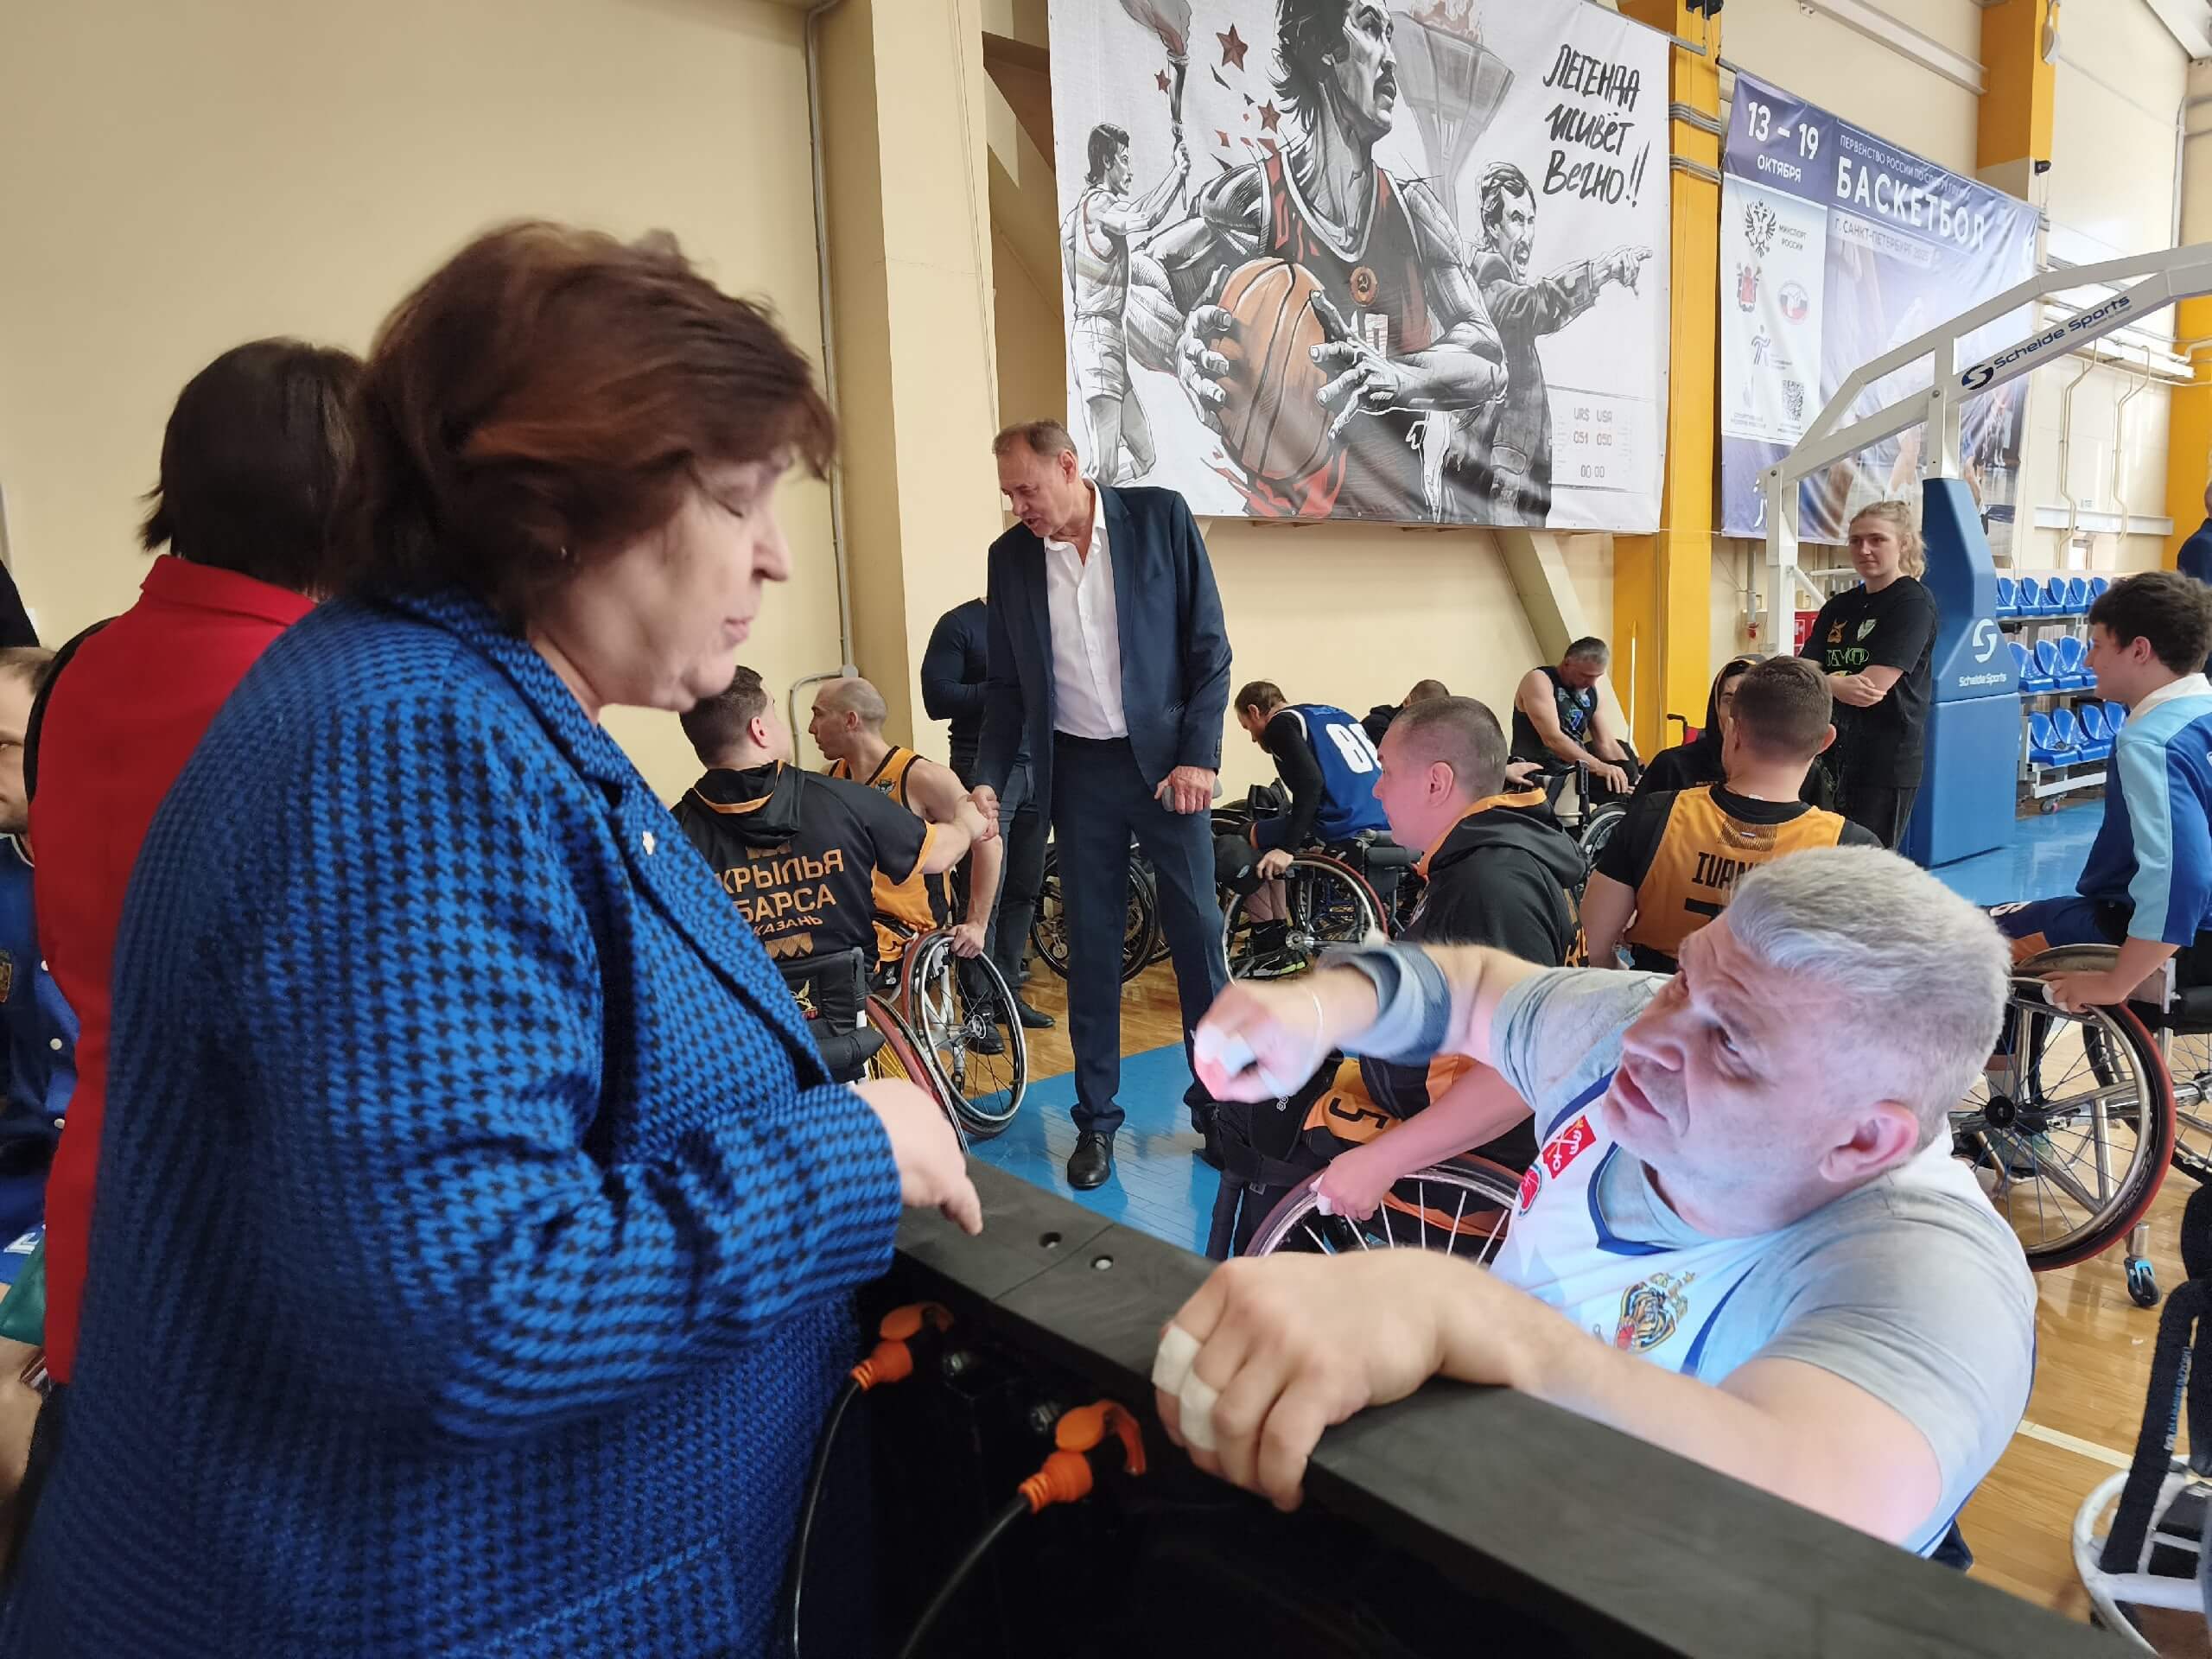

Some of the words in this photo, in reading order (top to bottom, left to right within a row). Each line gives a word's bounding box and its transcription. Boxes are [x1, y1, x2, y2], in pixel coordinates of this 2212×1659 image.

[1747, 101, 1771, 142] 13
[1798, 123, 1820, 160] 19
[1757, 154, 1802, 183] ОКТЯБРЯ
[1840, 134, 1885, 164] ПЕРВЕНСТВО
[1886, 155, 1915, 177] РОССИИ
[1835, 156, 1985, 251] БАСКЕТБОЛ
[1842, 219, 1912, 254] САНКТ-ПЕТЕРБУРГ
[1993, 329, 2066, 369] Scheide
[2069, 296, 2131, 332] Sports
[715, 849, 844, 894] КРЫЛЬЯ
[733, 883, 836, 923] БАРСА
[753, 915, 823, 937] КАЗАНЬ
[1328, 1096, 1389, 1129] 5
